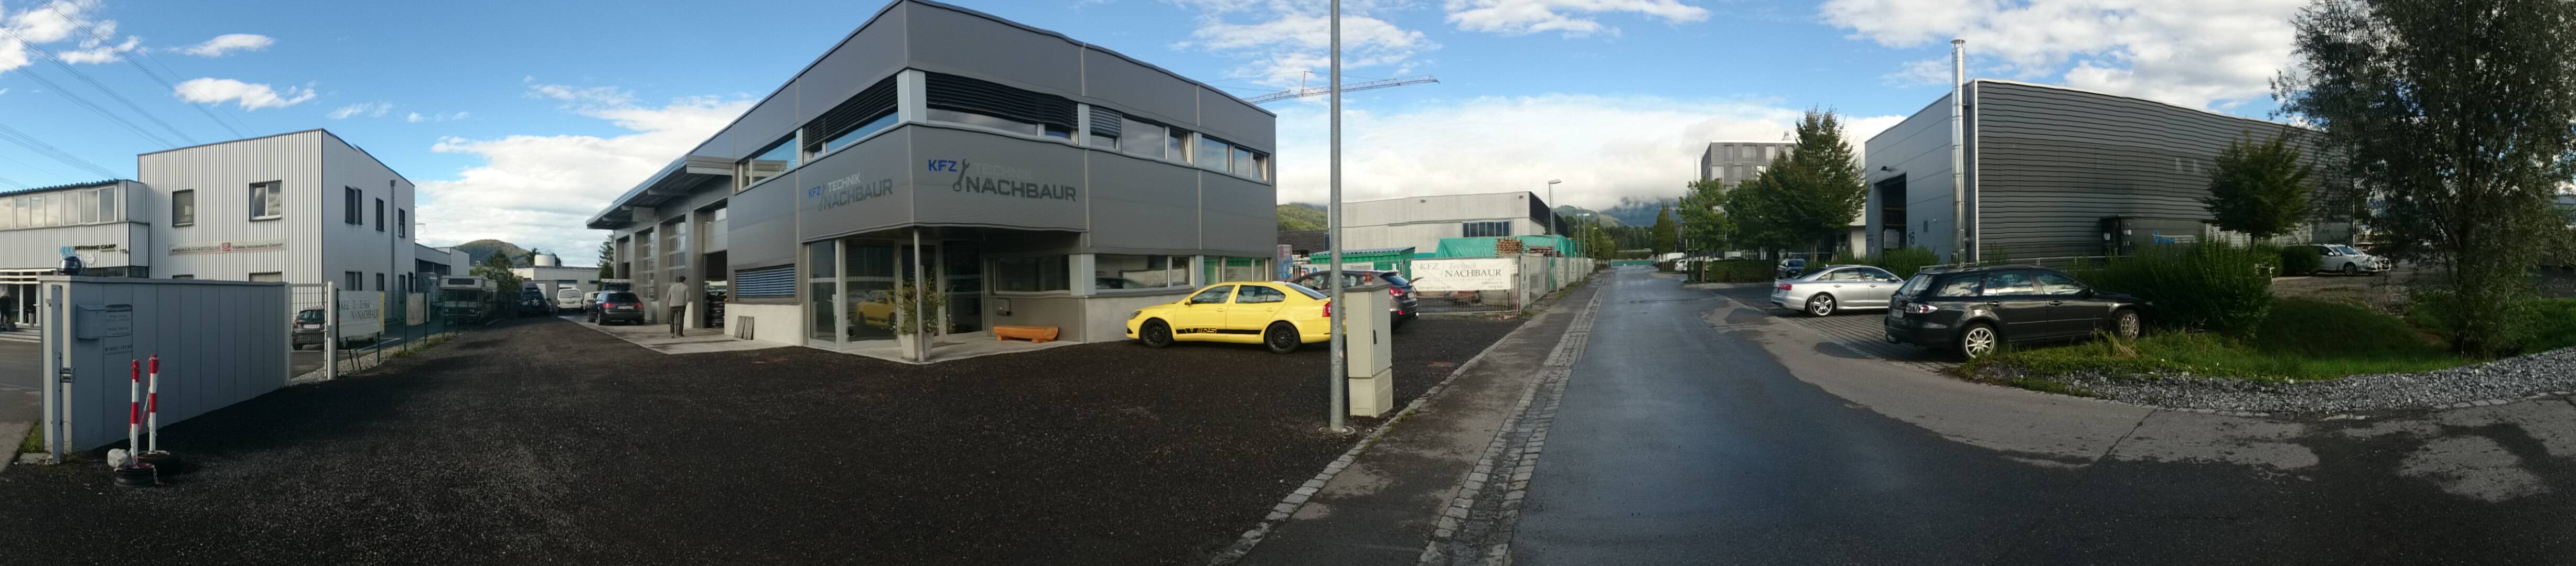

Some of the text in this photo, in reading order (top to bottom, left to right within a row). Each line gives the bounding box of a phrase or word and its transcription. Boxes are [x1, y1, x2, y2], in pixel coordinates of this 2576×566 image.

[928, 159, 957, 172] KFZ
[808, 172, 861, 198] KFZ TECHNIK
[966, 176, 1077, 202] NACHBAUR
[824, 178, 893, 210] NACHBAUR
[1908, 231, 1915, 245] 16
[1445, 269, 1501, 277] NACHBAUR
[340, 300, 349, 310] KFZ
